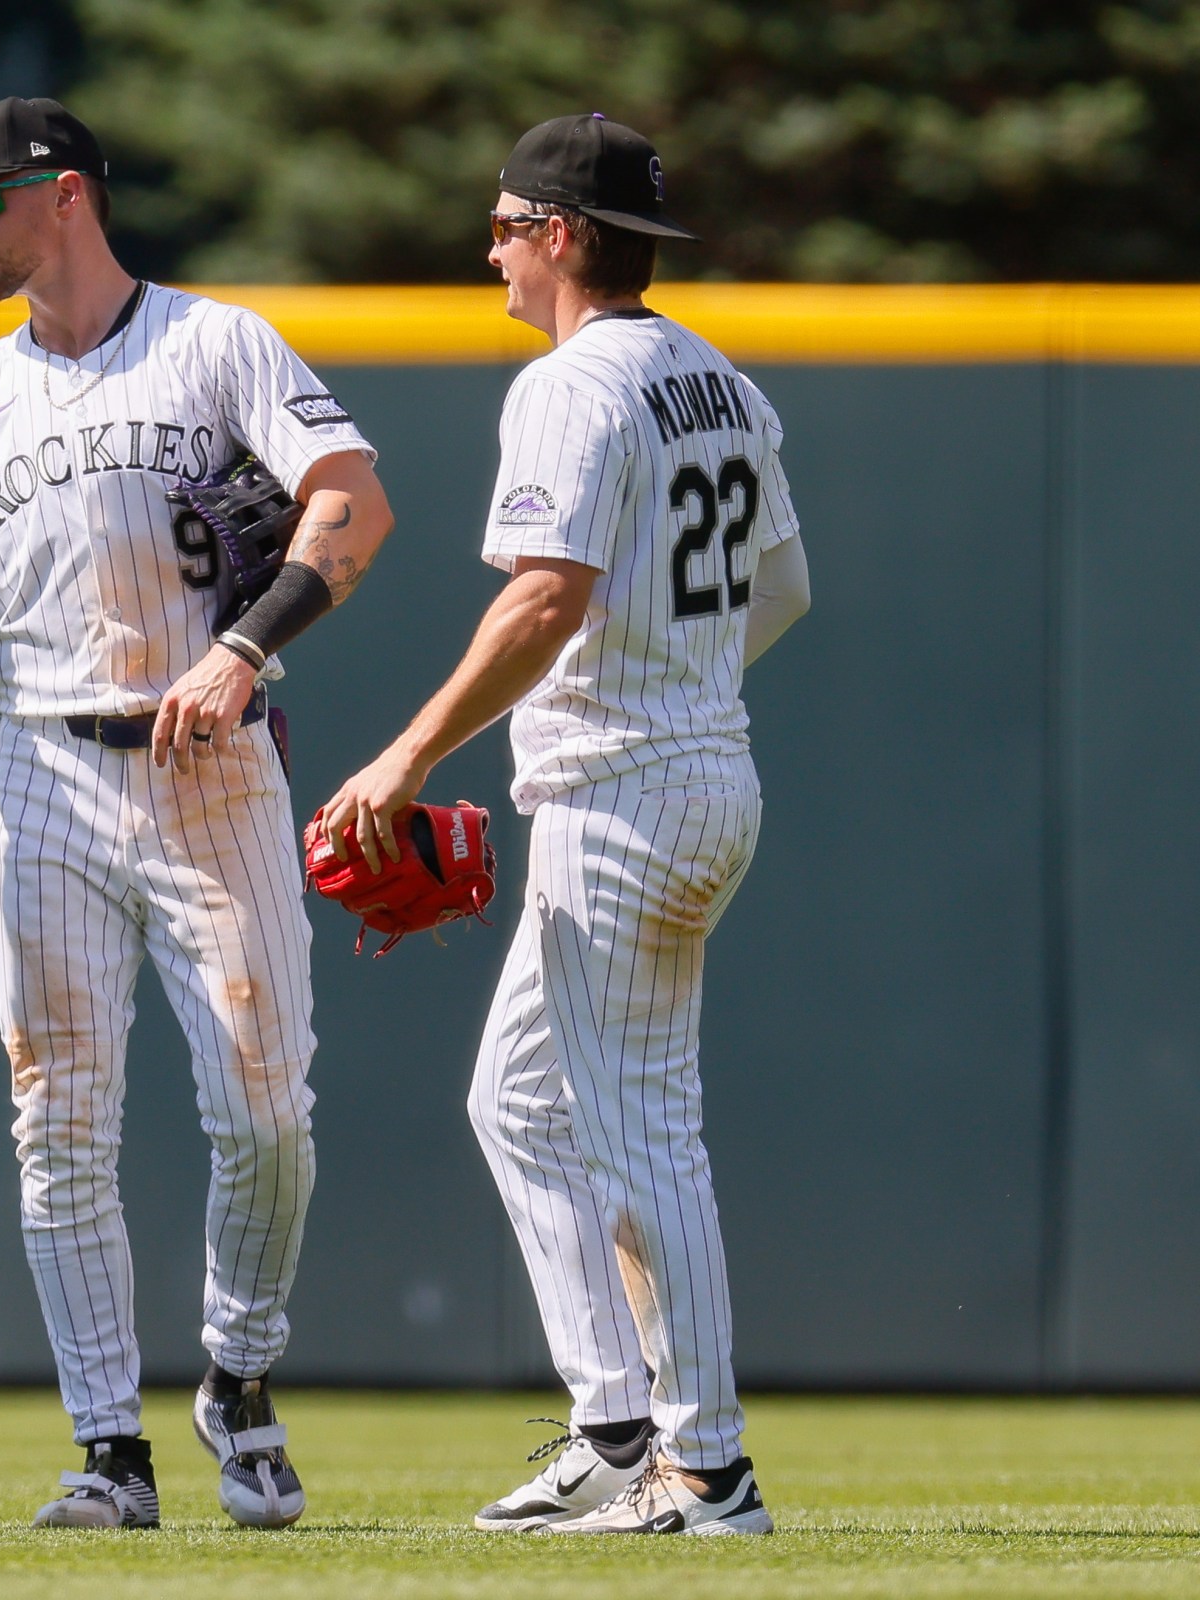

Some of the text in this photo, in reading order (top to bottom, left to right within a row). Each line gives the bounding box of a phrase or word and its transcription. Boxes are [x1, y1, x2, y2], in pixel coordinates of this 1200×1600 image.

[288, 398, 343, 416] YORK
[503, 485, 555, 507] COLORADO
[498, 509, 557, 522] ROCKIES
[172, 507, 221, 593] 9
[668, 454, 760, 622] 22
[451, 811, 469, 862] Wilson
